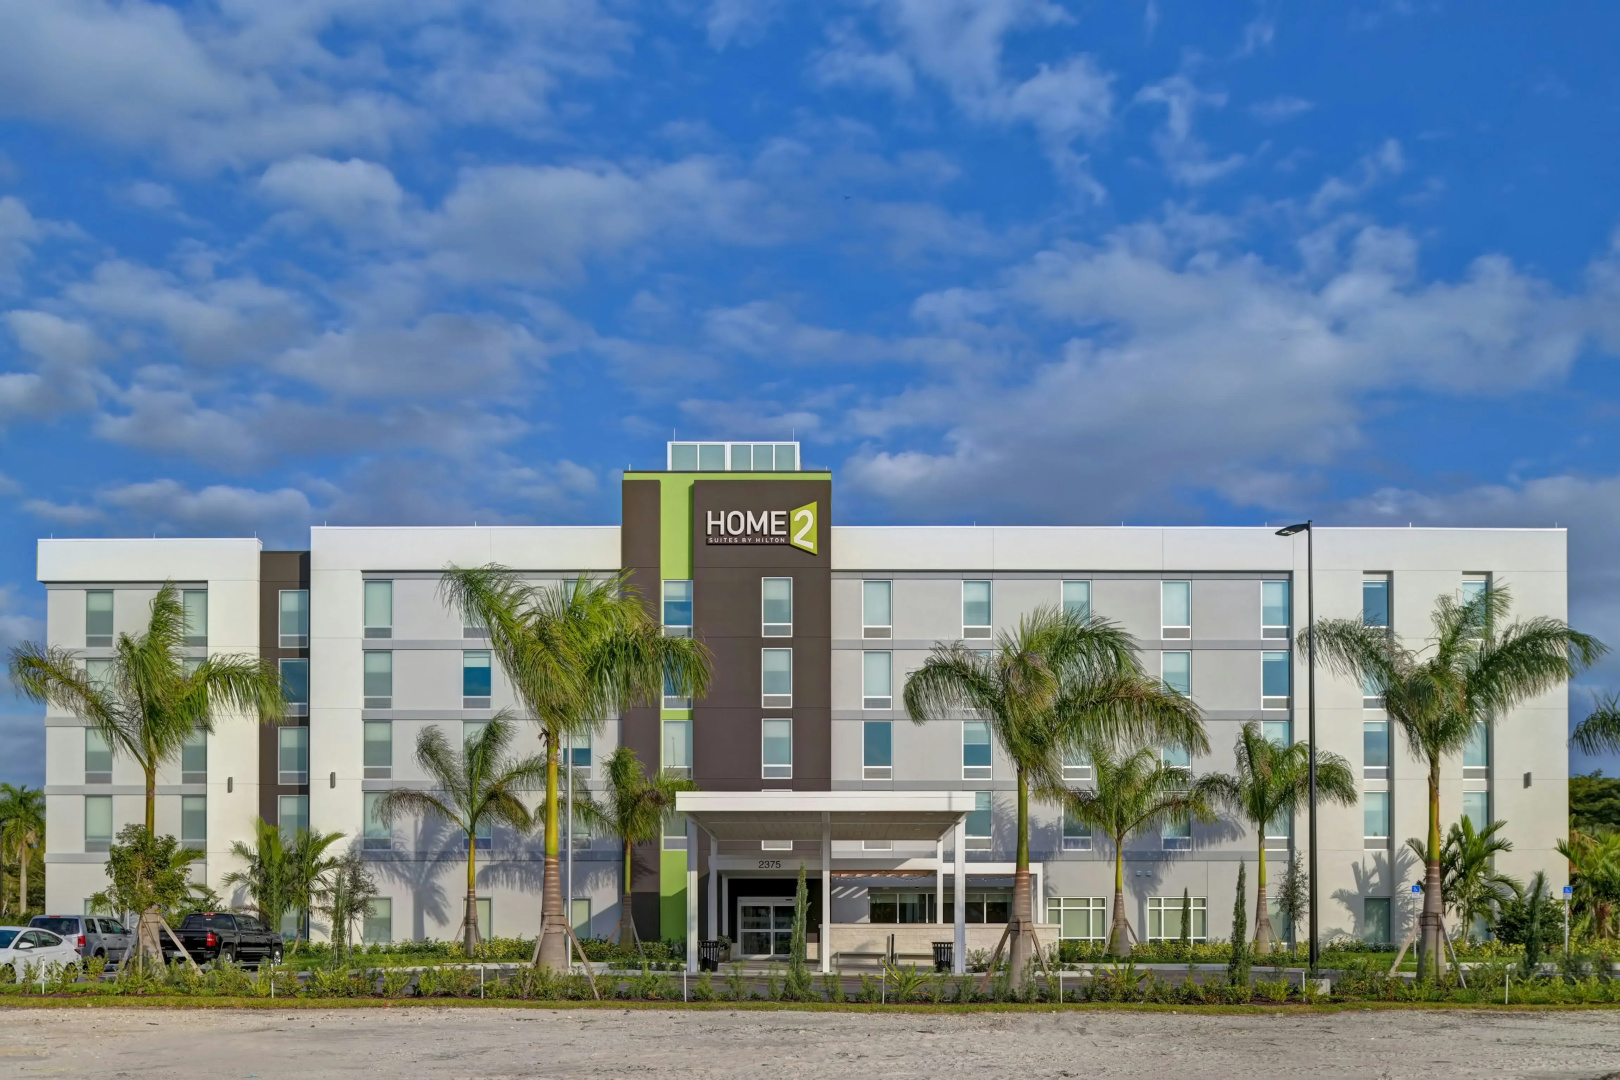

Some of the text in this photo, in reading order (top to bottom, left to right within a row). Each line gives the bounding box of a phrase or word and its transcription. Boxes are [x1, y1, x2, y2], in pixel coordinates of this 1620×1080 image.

[707, 509, 814, 550] HOME 2
[758, 860, 781, 869] 2375
